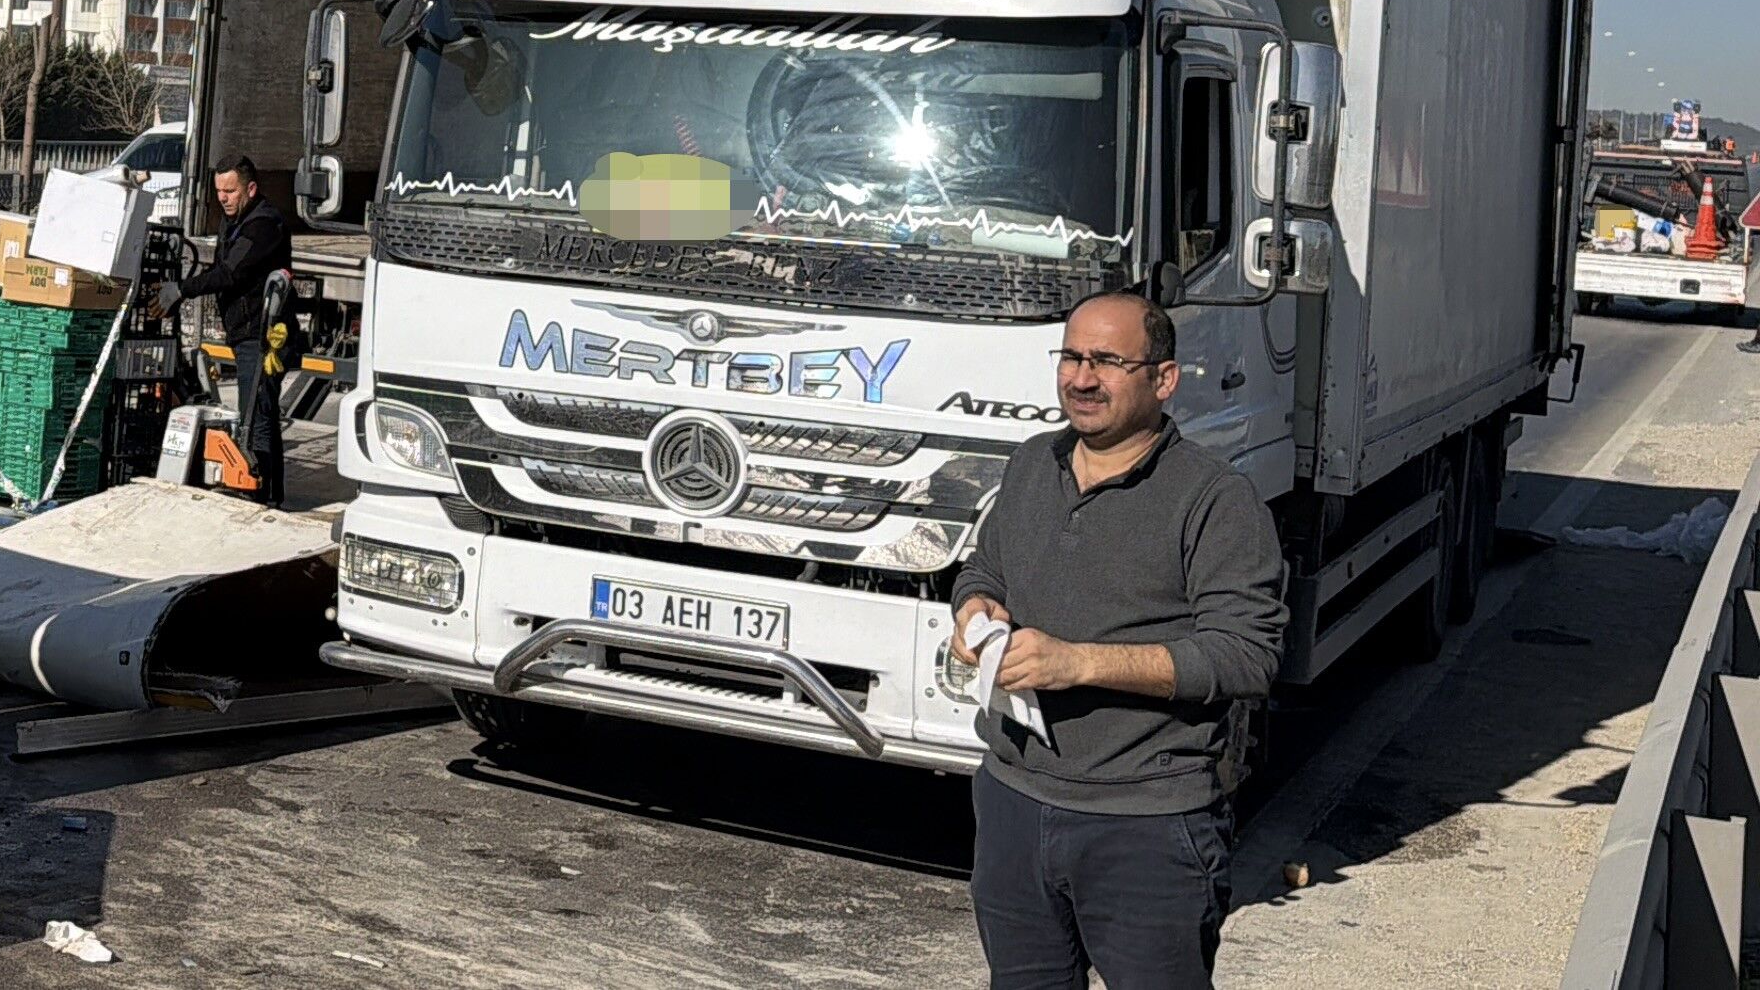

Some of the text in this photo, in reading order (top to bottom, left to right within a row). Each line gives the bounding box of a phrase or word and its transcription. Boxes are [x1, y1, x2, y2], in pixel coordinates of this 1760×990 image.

[498, 309, 912, 403] MERTBEY
[936, 391, 1069, 424] ATEGO
[595, 587, 782, 642] TR 03 AEH 137
